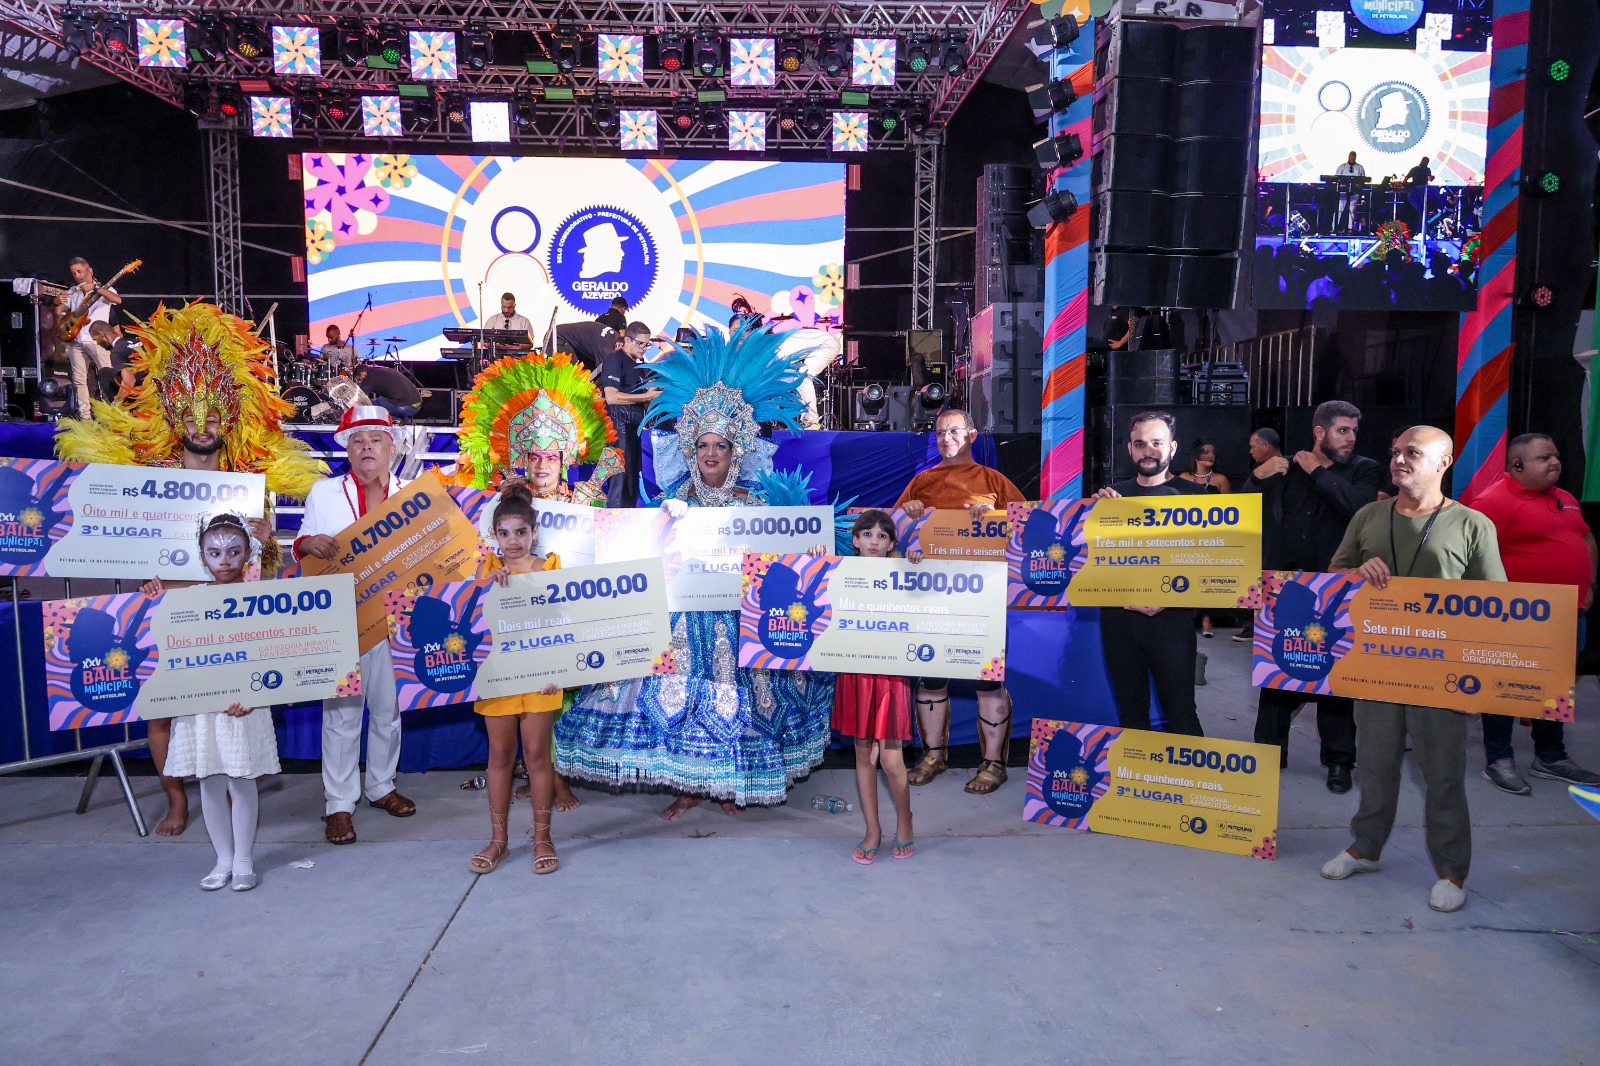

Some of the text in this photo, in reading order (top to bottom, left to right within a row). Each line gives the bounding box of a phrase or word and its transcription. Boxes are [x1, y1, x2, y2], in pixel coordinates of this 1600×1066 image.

[1154, 2, 1167, 15] R
[1364, 0, 1415, 12] MUNICIPAL
[559, 213, 592, 247] COMEMORATIVO
[598, 212, 631, 227] PREFEITURA
[631, 225, 639, 233] DE
[637, 233, 649, 265] PETROLINA
[572, 281, 629, 292] GERALDO
[122, 487, 138, 498] R$
[141, 480, 249, 504] 4.800,00
[83, 504, 106, 516] Oito
[110, 509, 128, 517] mil
[142, 510, 199, 521] quatrocen
[1128, 518, 1141, 526] R$
[1143, 507, 1239, 528] 3.700,00
[82, 525, 162, 537] 3º LUGAR
[340, 492, 431, 566] R$ 4.700,00
[718, 526, 730, 536] R$
[733, 516, 821, 536] 9.000,00
[958, 528, 969, 537] R$
[359, 565, 374, 579] mil
[376, 561, 382, 569] e
[382, 533, 422, 564] setecentos
[423, 516, 445, 534] reais
[1095, 536, 1115, 547] Três
[1119, 538, 1134, 547] mil
[1146, 539, 1194, 547] setecentos
[1199, 537, 1224, 546] reais
[402, 539, 436, 565] CATEGORIA
[406, 535, 452, 569] ORIGINALIDADE
[712, 546, 726, 555] mil
[730, 545, 752, 554] reais
[929, 544, 946, 555] Três
[950, 547, 963, 555] mil
[1031, 550, 1044, 558] XXV
[688, 563, 743, 572] 1º LUGA
[1030, 557, 1066, 571] BAILE
[1095, 556, 1160, 565] 1º LUGAR
[1030, 570, 1066, 580] MUNICIPAL
[531, 594, 546, 606] R$
[547, 573, 648, 604] 2.000,00
[874, 580, 888, 590] R$
[889, 571, 983, 595] 1.500,00
[205, 609, 221, 620] R$
[223, 589, 332, 619] 2.700,00
[840, 597, 855, 610] Mil
[867, 601, 920, 613] quinhentos
[924, 605, 949, 614] reais
[1404, 602, 1421, 613] R$
[1424, 593, 1550, 622] 7.000,00
[769, 608, 784, 617] XXV
[498, 615, 571, 633] Dois mil reais
[768, 616, 808, 632] BAILE
[839, 619, 909, 632] 3º LUGAR
[1363, 620, 1446, 638] Sete mil reais
[167, 634, 191, 649] Dois
[196, 633, 213, 645] mil
[229, 629, 284, 642] setecentos
[289, 624, 317, 635] reais
[768, 630, 808, 641] MUNICIPAL
[1284, 628, 1301, 637] XXV
[424, 643, 440, 653] XXV
[501, 634, 575, 651] 2º LUGAR
[1284, 637, 1328, 654] BAILE
[259, 649, 296, 658] FANTASIA
[1284, 652, 1327, 663] MUNICIPAL
[1363, 643, 1444, 659] 1º LUGAR
[1462, 649, 1518, 659] CATEGORIA
[83, 658, 101, 668] XXV
[168, 651, 247, 668] 1º LUGAR
[425, 650, 470, 668] BAILE
[1462, 656, 1538, 668] ORIGINALIDADE
[83, 665, 132, 684] BAILE
[305, 667, 334, 675] PETROLINA
[427, 663, 471, 677] MUNICIPAL
[84, 679, 133, 694] MUNICIPAL
[1508, 682, 1541, 691] PETROLINA
[1150, 753, 1164, 763] R$
[1166, 746, 1256, 774] 1.500,00
[1053, 770, 1067, 778] XXV
[1118, 766, 1132, 779] Mil
[1144, 774, 1194, 788] quinhentos
[1198, 781, 1222, 791] reais
[1052, 778, 1088, 795] BAILE
[1052, 791, 1088, 802] MUNICIPAL
[1117, 786, 1183, 804] 3º LUGAR
